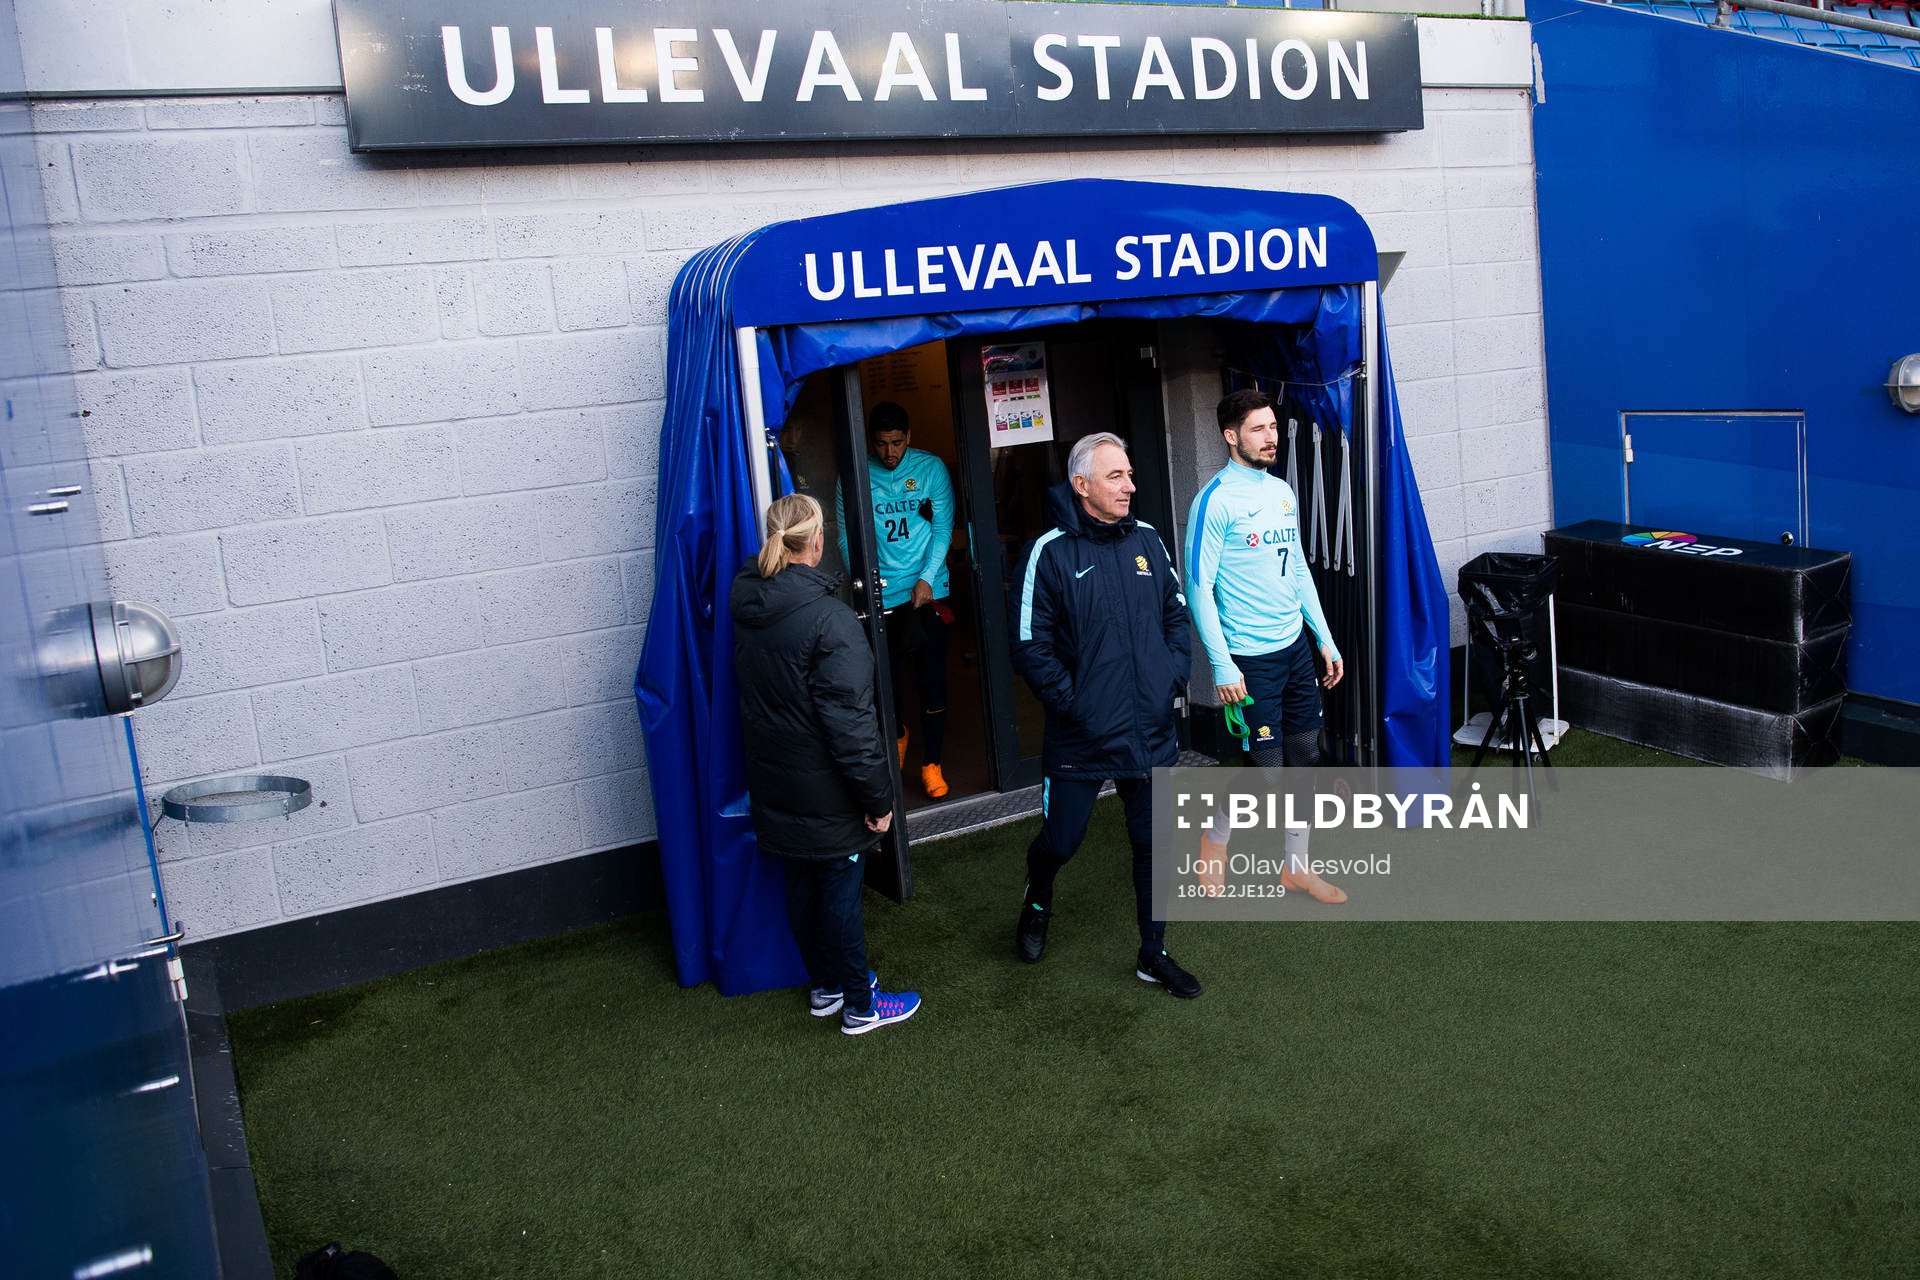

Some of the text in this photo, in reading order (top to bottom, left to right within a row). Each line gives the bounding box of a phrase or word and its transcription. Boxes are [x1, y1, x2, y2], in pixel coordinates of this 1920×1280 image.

[441, 26, 1370, 106] ULLEVAAL STADION
[804, 226, 1328, 301] ULLEVAAL STADION
[884, 517, 910, 543] 24
[1277, 547, 1289, 577] 7
[1643, 539, 1744, 556] NEP
